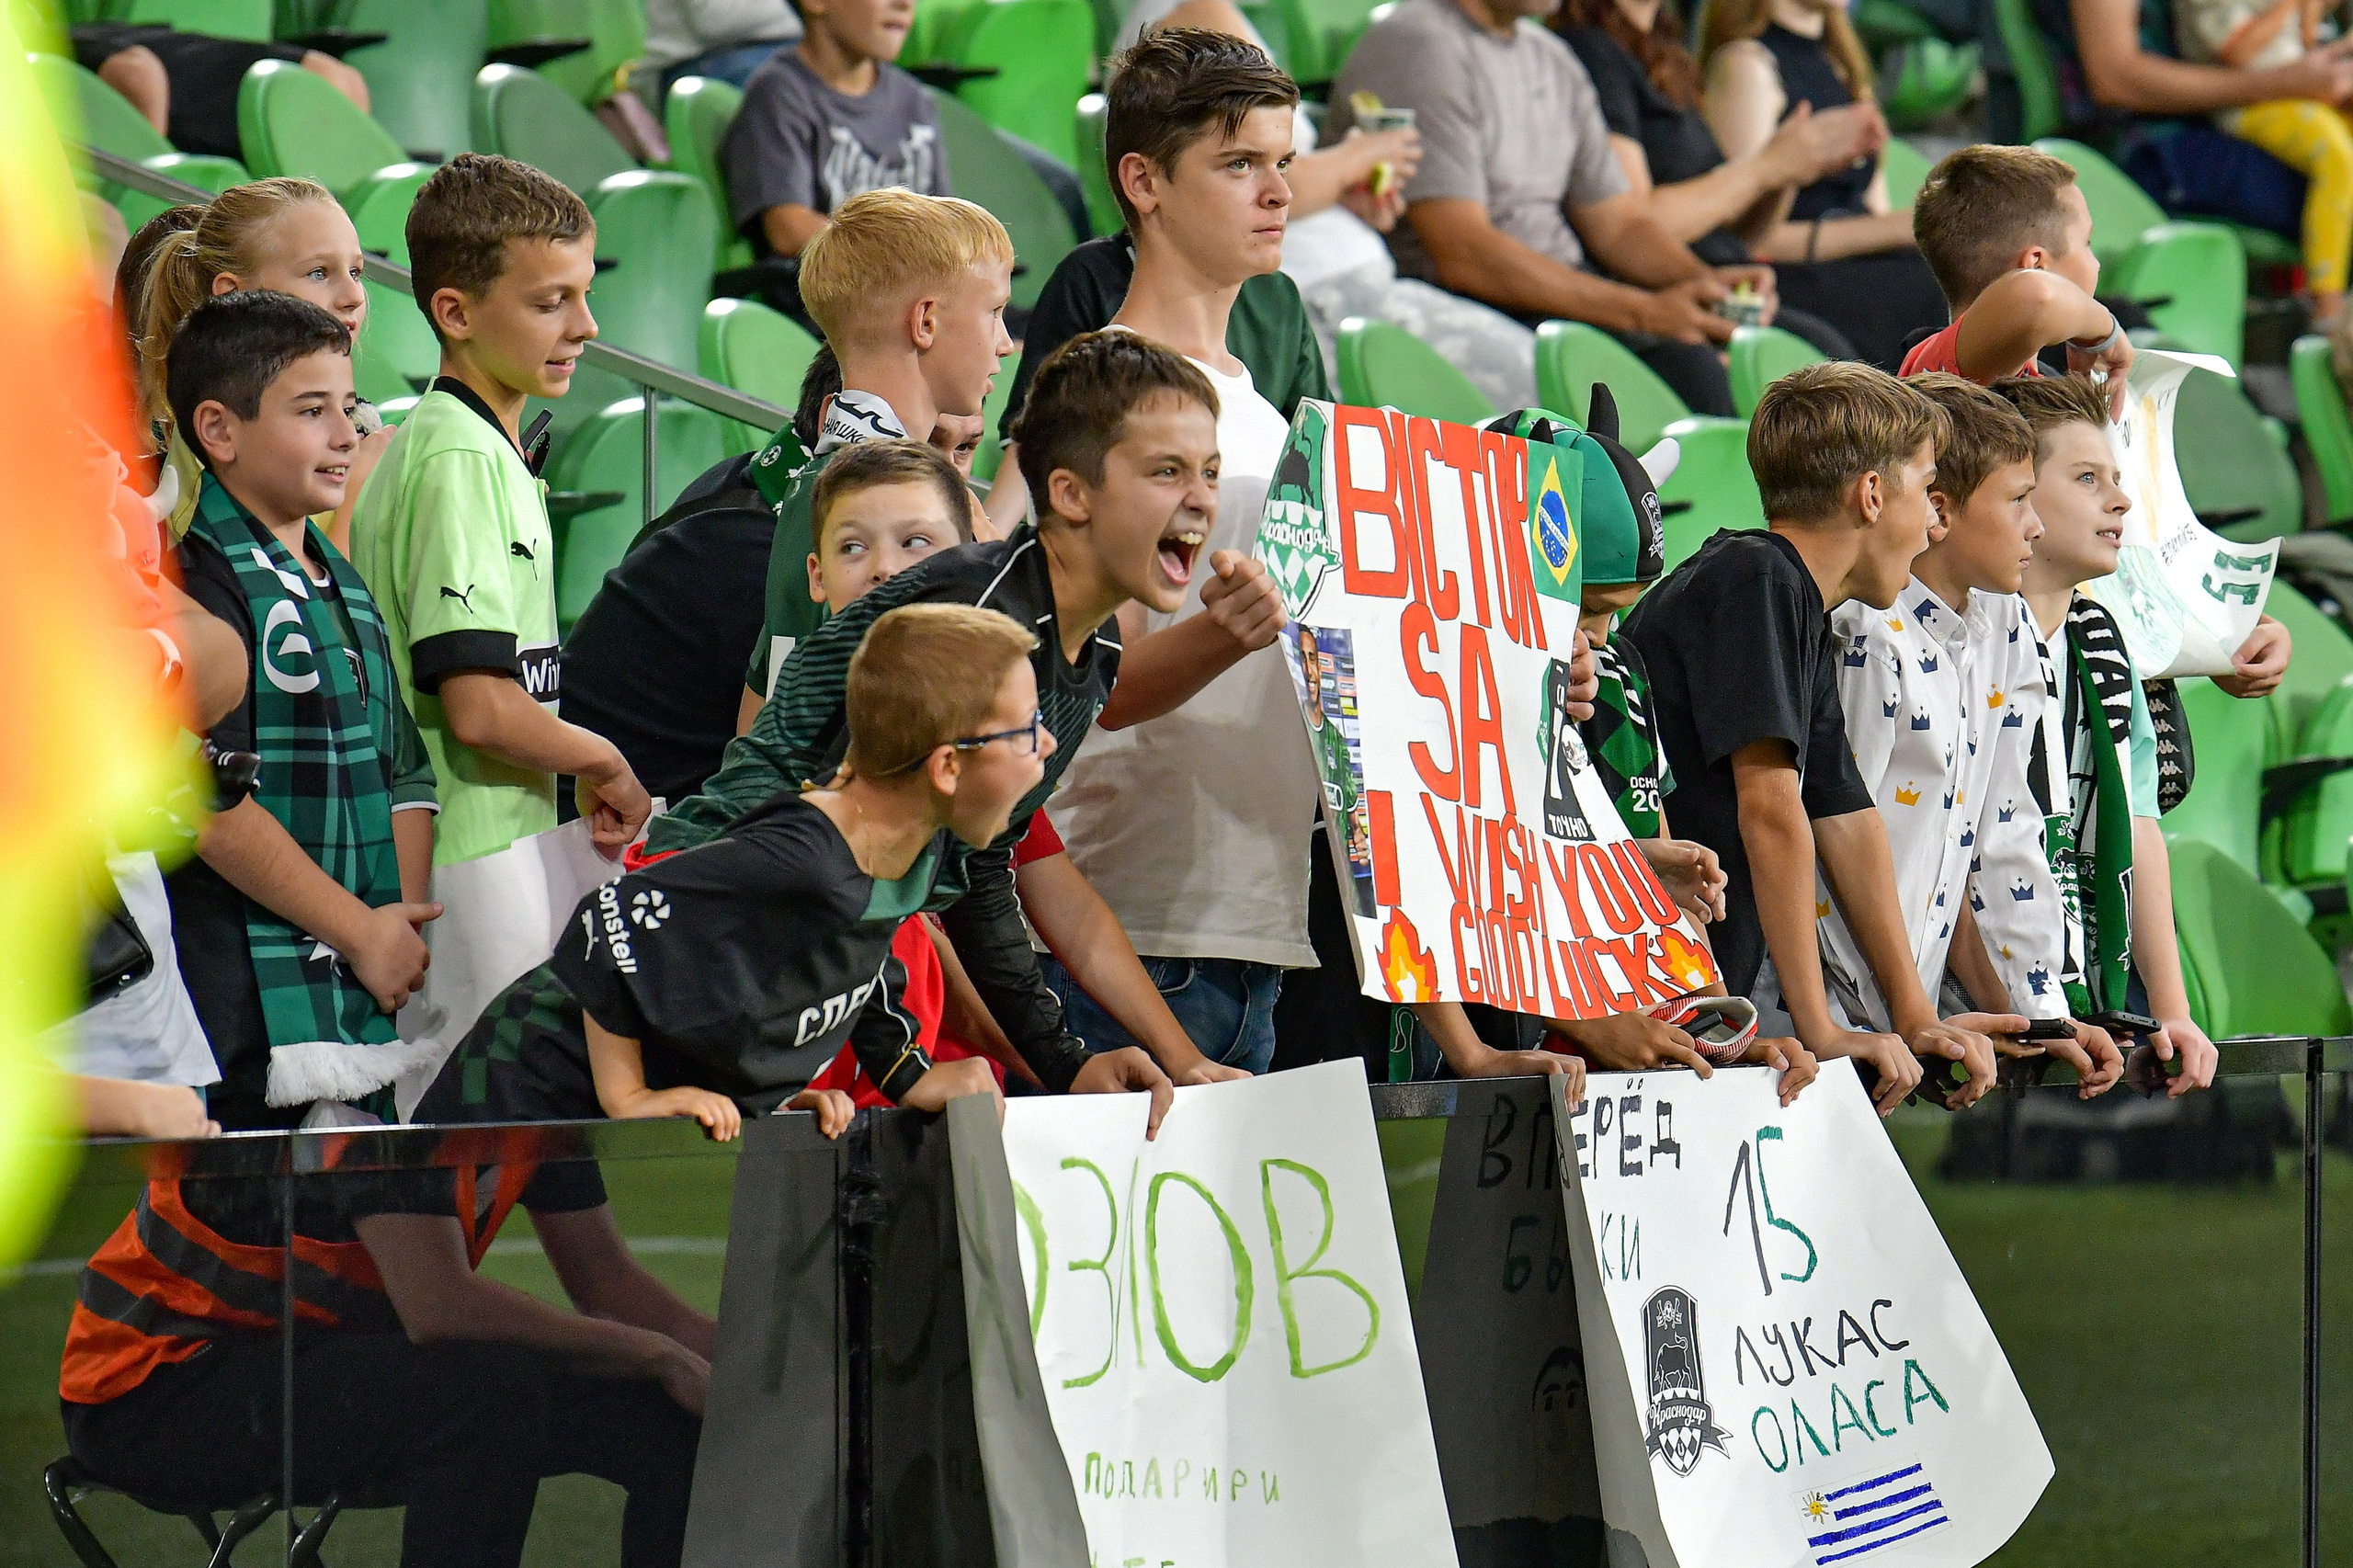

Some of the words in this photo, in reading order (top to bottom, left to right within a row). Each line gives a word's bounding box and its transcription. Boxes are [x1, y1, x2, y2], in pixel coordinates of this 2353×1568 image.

[1401, 602, 1517, 814] SA
[1631, 790, 1659, 812] 20
[1366, 790, 1402, 907] I
[1420, 792, 1549, 937] WISH
[1542, 838, 1681, 938] YOU
[1449, 901, 1540, 1016] GOOD
[1541, 932, 1681, 1020] LUCK
[1723, 1126, 1818, 1296] 15
[1735, 1299, 1910, 1387] ЛУКАС
[1649, 1402, 1707, 1430] Краснодар
[1751, 1358, 1950, 1472] ОЛАСА
